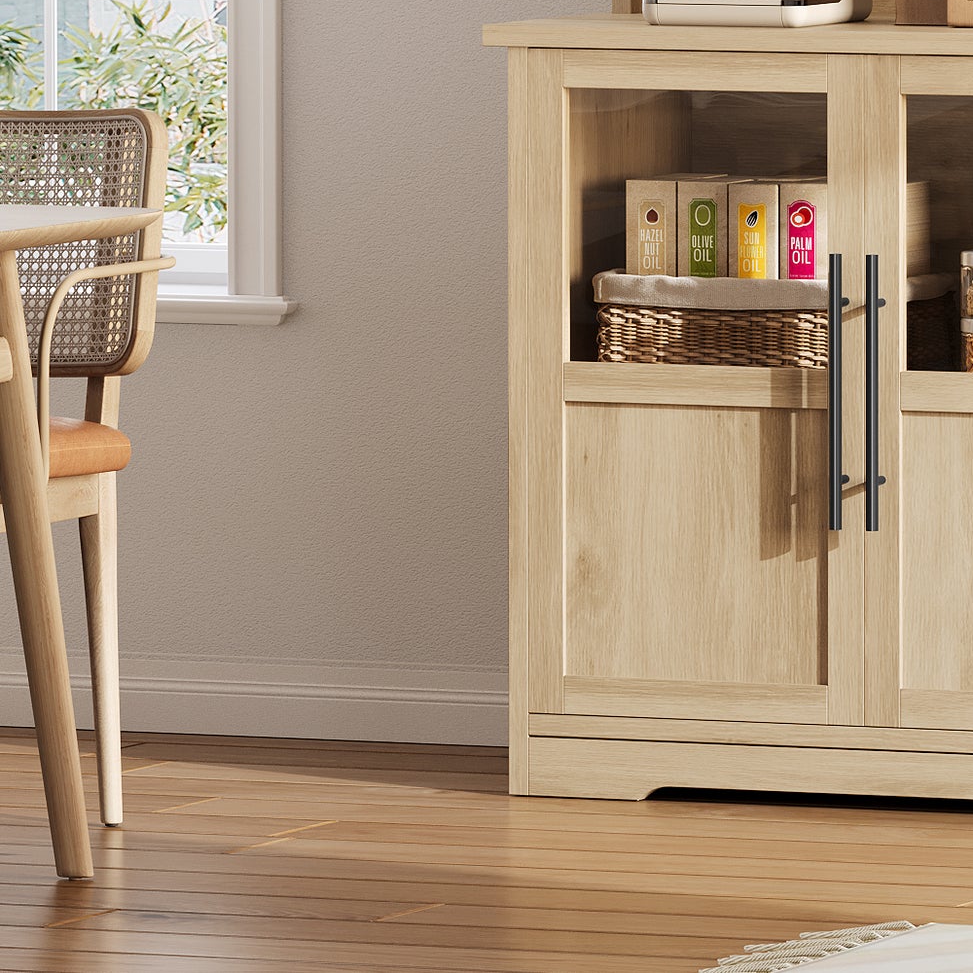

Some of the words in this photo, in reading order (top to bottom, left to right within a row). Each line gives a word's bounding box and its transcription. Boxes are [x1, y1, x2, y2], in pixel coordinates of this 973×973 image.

[640, 228, 664, 242] HAZEL
[691, 234, 714, 249] OLIVE
[743, 231, 760, 245] SUN
[644, 242, 661, 256] NUT
[790, 236, 813, 251] PALM
[693, 248, 712, 263] OIL
[740, 245, 764, 259] FLOWER
[791, 250, 812, 265] OIL
[642, 255, 662, 270] OIL
[742, 258, 761, 273] OIL
